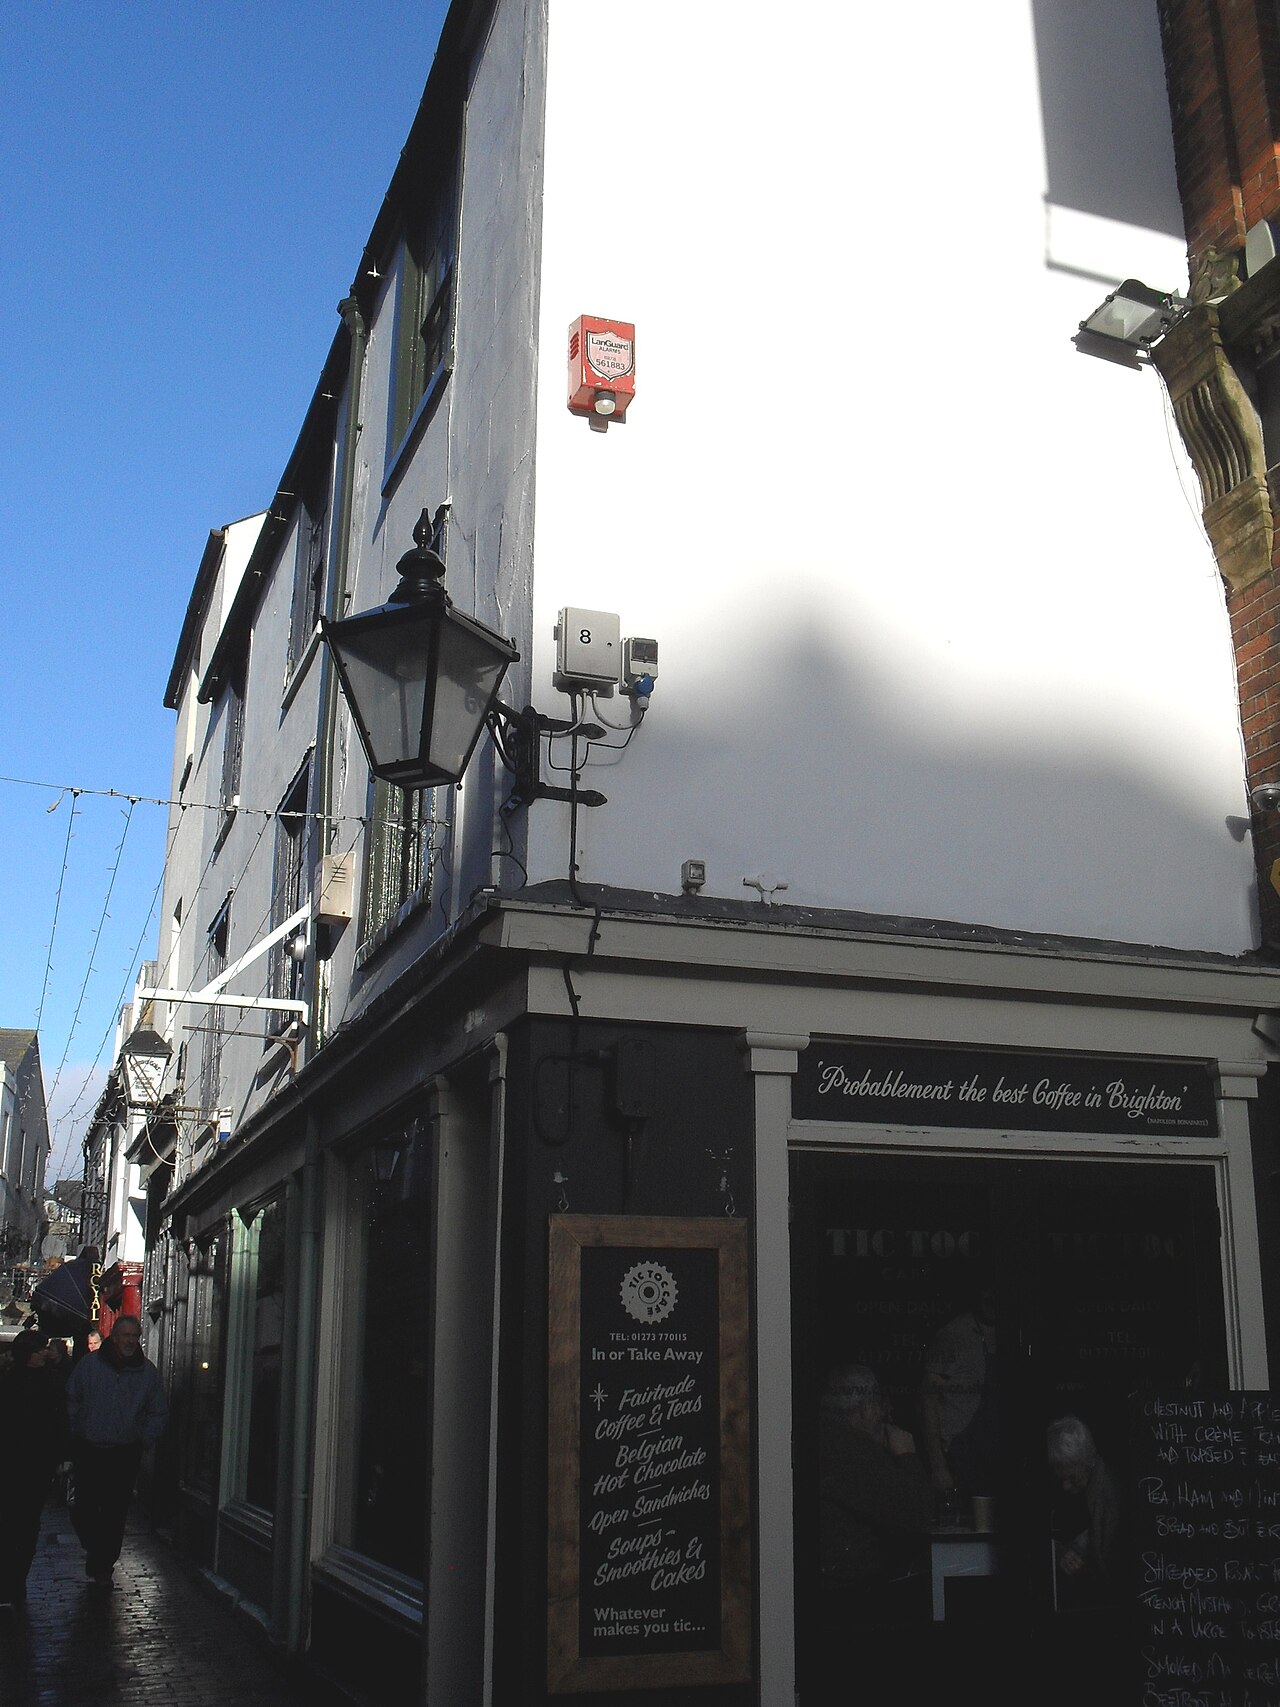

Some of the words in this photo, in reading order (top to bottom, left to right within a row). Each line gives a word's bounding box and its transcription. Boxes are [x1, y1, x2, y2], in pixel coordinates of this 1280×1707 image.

[591, 337, 628, 350] LanGuard
[596, 359, 625, 370] 561883
[579, 629, 591, 644] 8
[959, 1074, 987, 1102] the
[992, 1076, 1029, 1103] best
[1032, 1078, 1082, 1110] Coffee
[1085, 1086, 1102, 1108] in
[826, 1228, 895, 1258] TIC
[905, 1230, 981, 1259] TOC
[609, 1332, 630, 1341] TEL:
[631, 1332, 656, 1341] 01273
[658, 1332, 687, 1341] 770115
[592, 1347, 605, 1361] In
[609, 1351, 625, 1361] or
[627, 1347, 661, 1361] Take
[663, 1347, 703, 1364] Away
[618, 1374, 696, 1411] Fairtrade
[595, 1413, 646, 1440] Coffee
[649, 1403, 663, 1425] &
[666, 1395, 702, 1420] Teas
[1152, 1422, 1187, 1443] WITH
[615, 1435, 684, 1468] Belgian
[593, 1468, 629, 1496] Hot
[633, 1447, 707, 1484] Chocolate
[588, 1509, 629, 1535] Open
[632, 1480, 710, 1518] Sandwiches
[593, 1547, 681, 1586] Smoothies
[685, 1536, 703, 1559] &
[650, 1560, 706, 1591] Cakes
[593, 1607, 666, 1621] Whatever
[593, 1622, 640, 1637] makes
[644, 1623, 669, 1638] you
[673, 1619, 706, 1632] tic...
